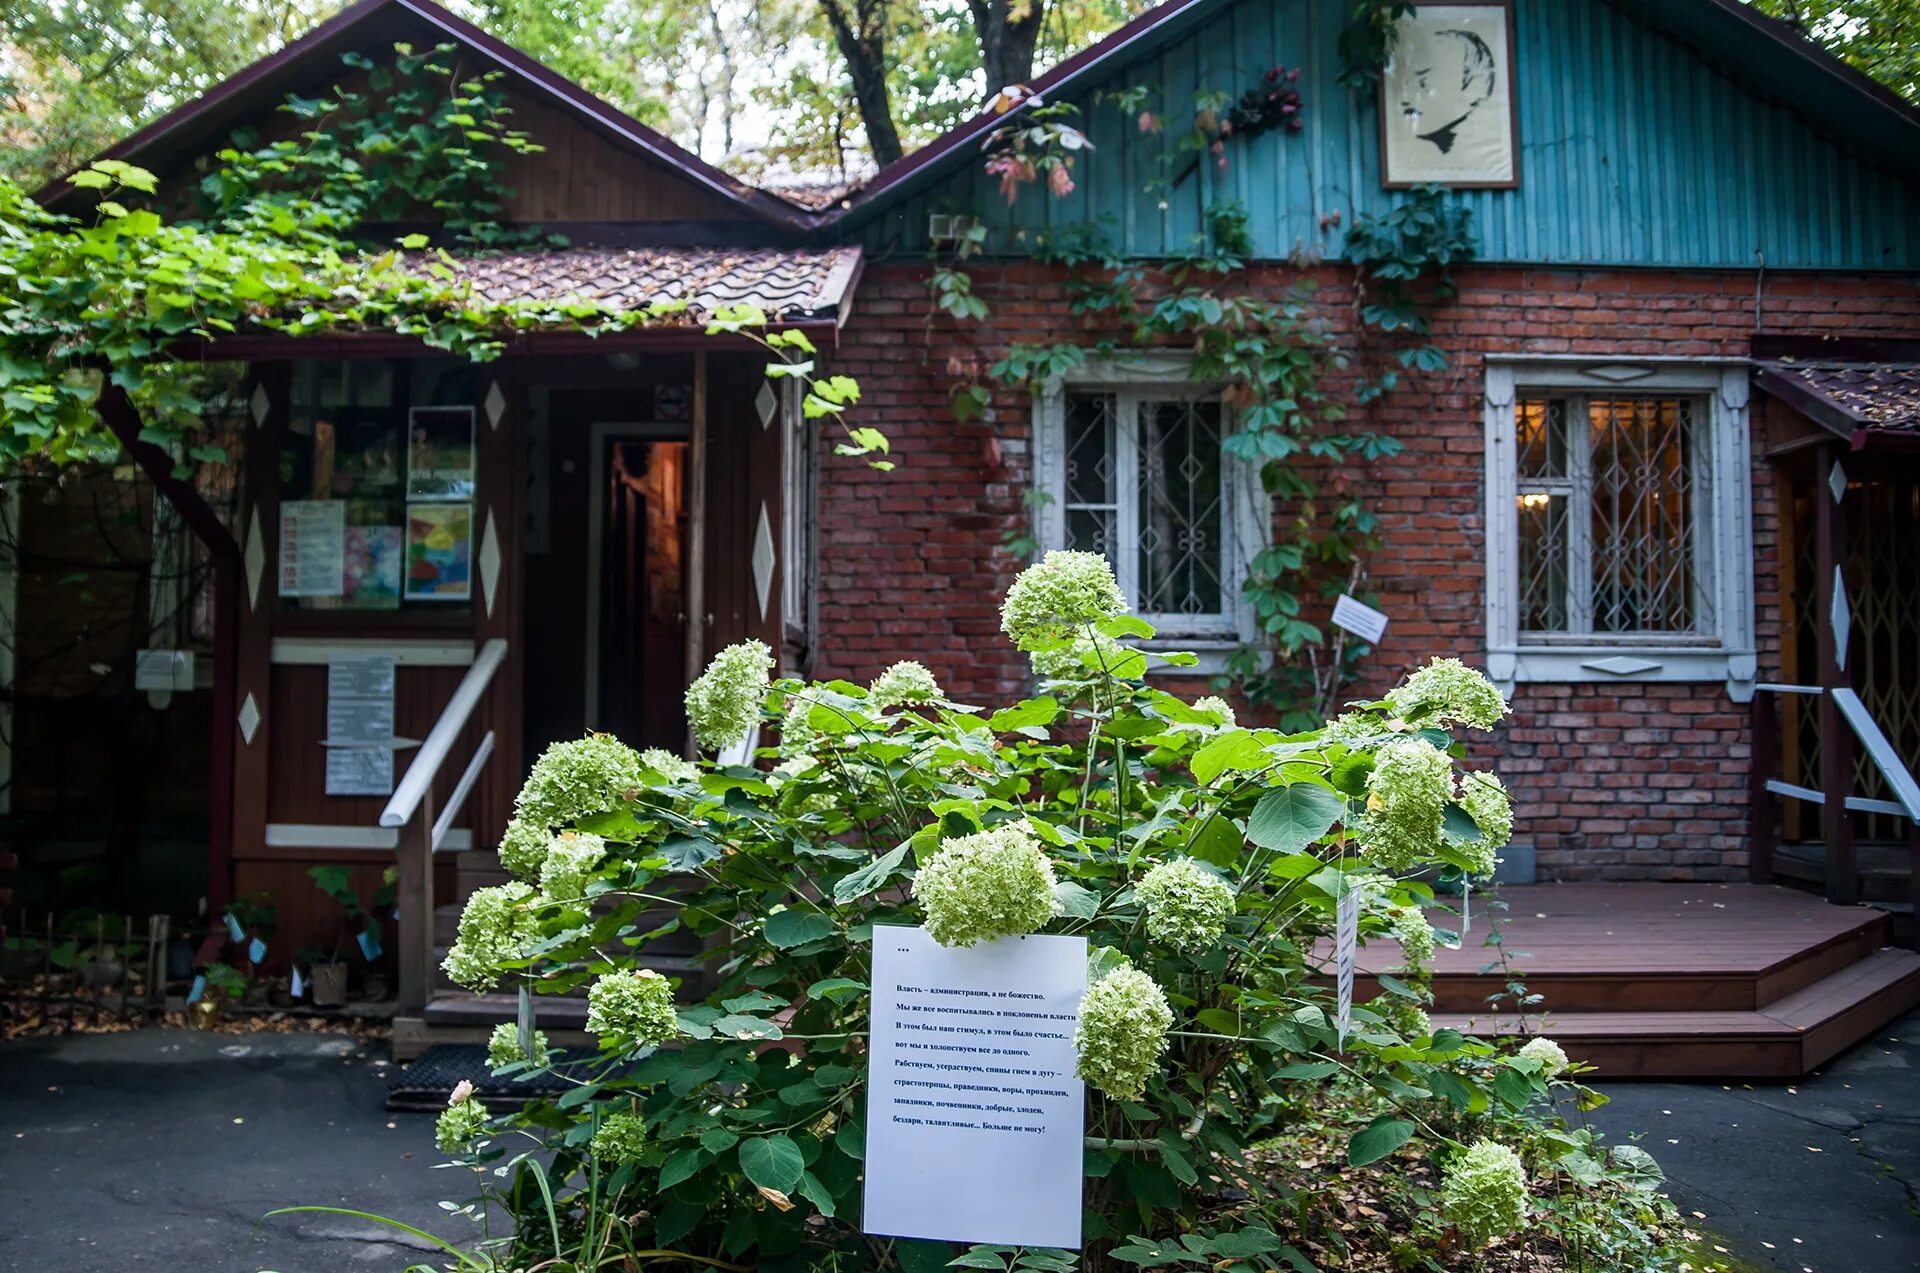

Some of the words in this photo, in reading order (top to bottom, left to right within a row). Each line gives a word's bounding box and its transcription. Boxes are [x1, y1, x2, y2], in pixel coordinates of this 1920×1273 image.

[896, 984, 923, 993] Власть
[930, 988, 991, 998] администрация,
[1008, 991, 1045, 1000] божество.
[896, 1003, 910, 1011] Мы
[937, 1007, 995, 1016] воспитывались
[1003, 1011, 1048, 1019] поклоненьи
[896, 1021, 902, 1029] В
[921, 1023, 937, 1031] был
[956, 1027, 986, 1036] стимул,
[1012, 1029, 1033, 1037] было
[1034, 1032, 1069, 1040] счастье...
[930, 1044, 977, 1054] холопствуем
[895, 1059, 935, 1070] Рабствуем,
[936, 1063, 984, 1073] усердствуем,
[1038, 1070, 1056, 1079] дугу
[953, 1084, 1001, 1093] праведники,
[1002, 1087, 1025, 1095] воры,
[936, 1101, 984, 1111] почвенники,
[985, 1104, 1015, 1113] добрые,
[925, 1119, 981, 1129] талантливые...
[982, 1122, 1012, 1131] Больше
[1024, 1126, 1045, 1135] могу!
